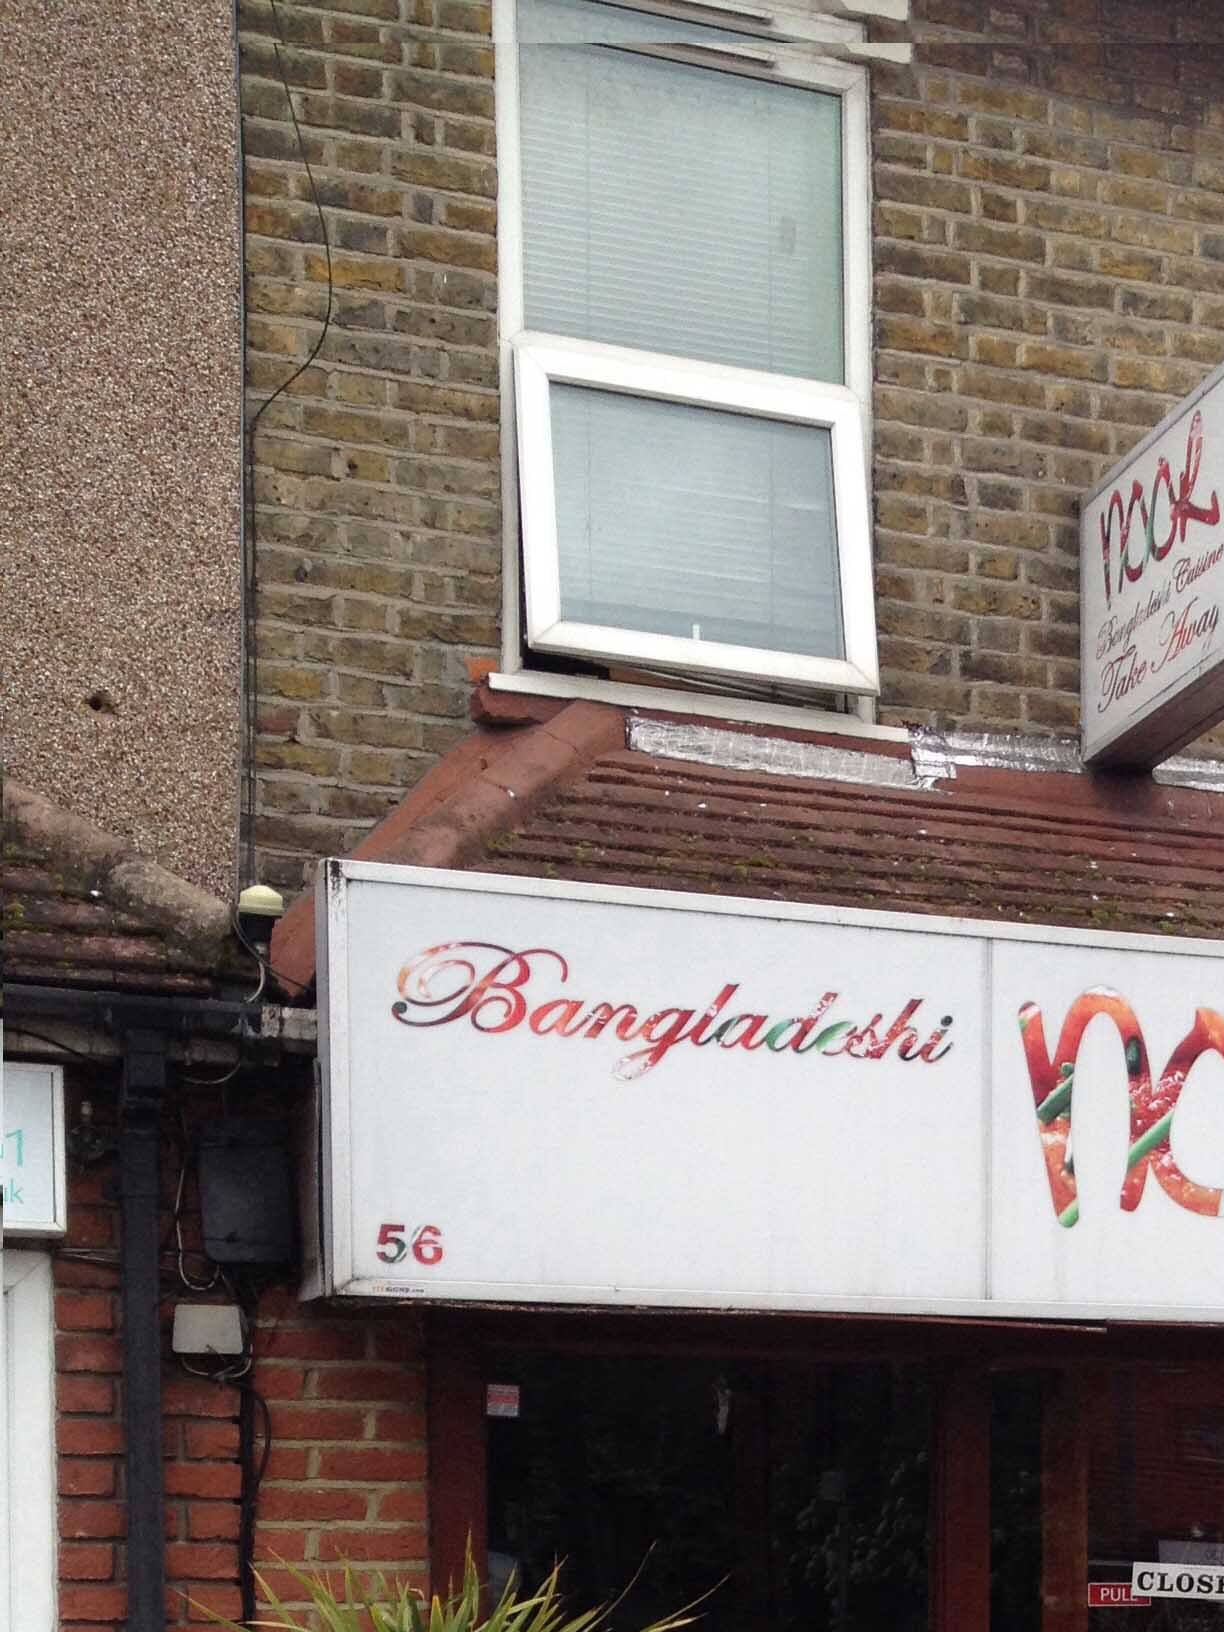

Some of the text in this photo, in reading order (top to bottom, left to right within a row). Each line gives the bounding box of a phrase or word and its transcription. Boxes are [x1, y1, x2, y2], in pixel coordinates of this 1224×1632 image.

[1097, 596, 1220, 713] Take Away
[391, 940, 954, 1081] Bangladeshi
[376, 1222, 444, 1266] 56
